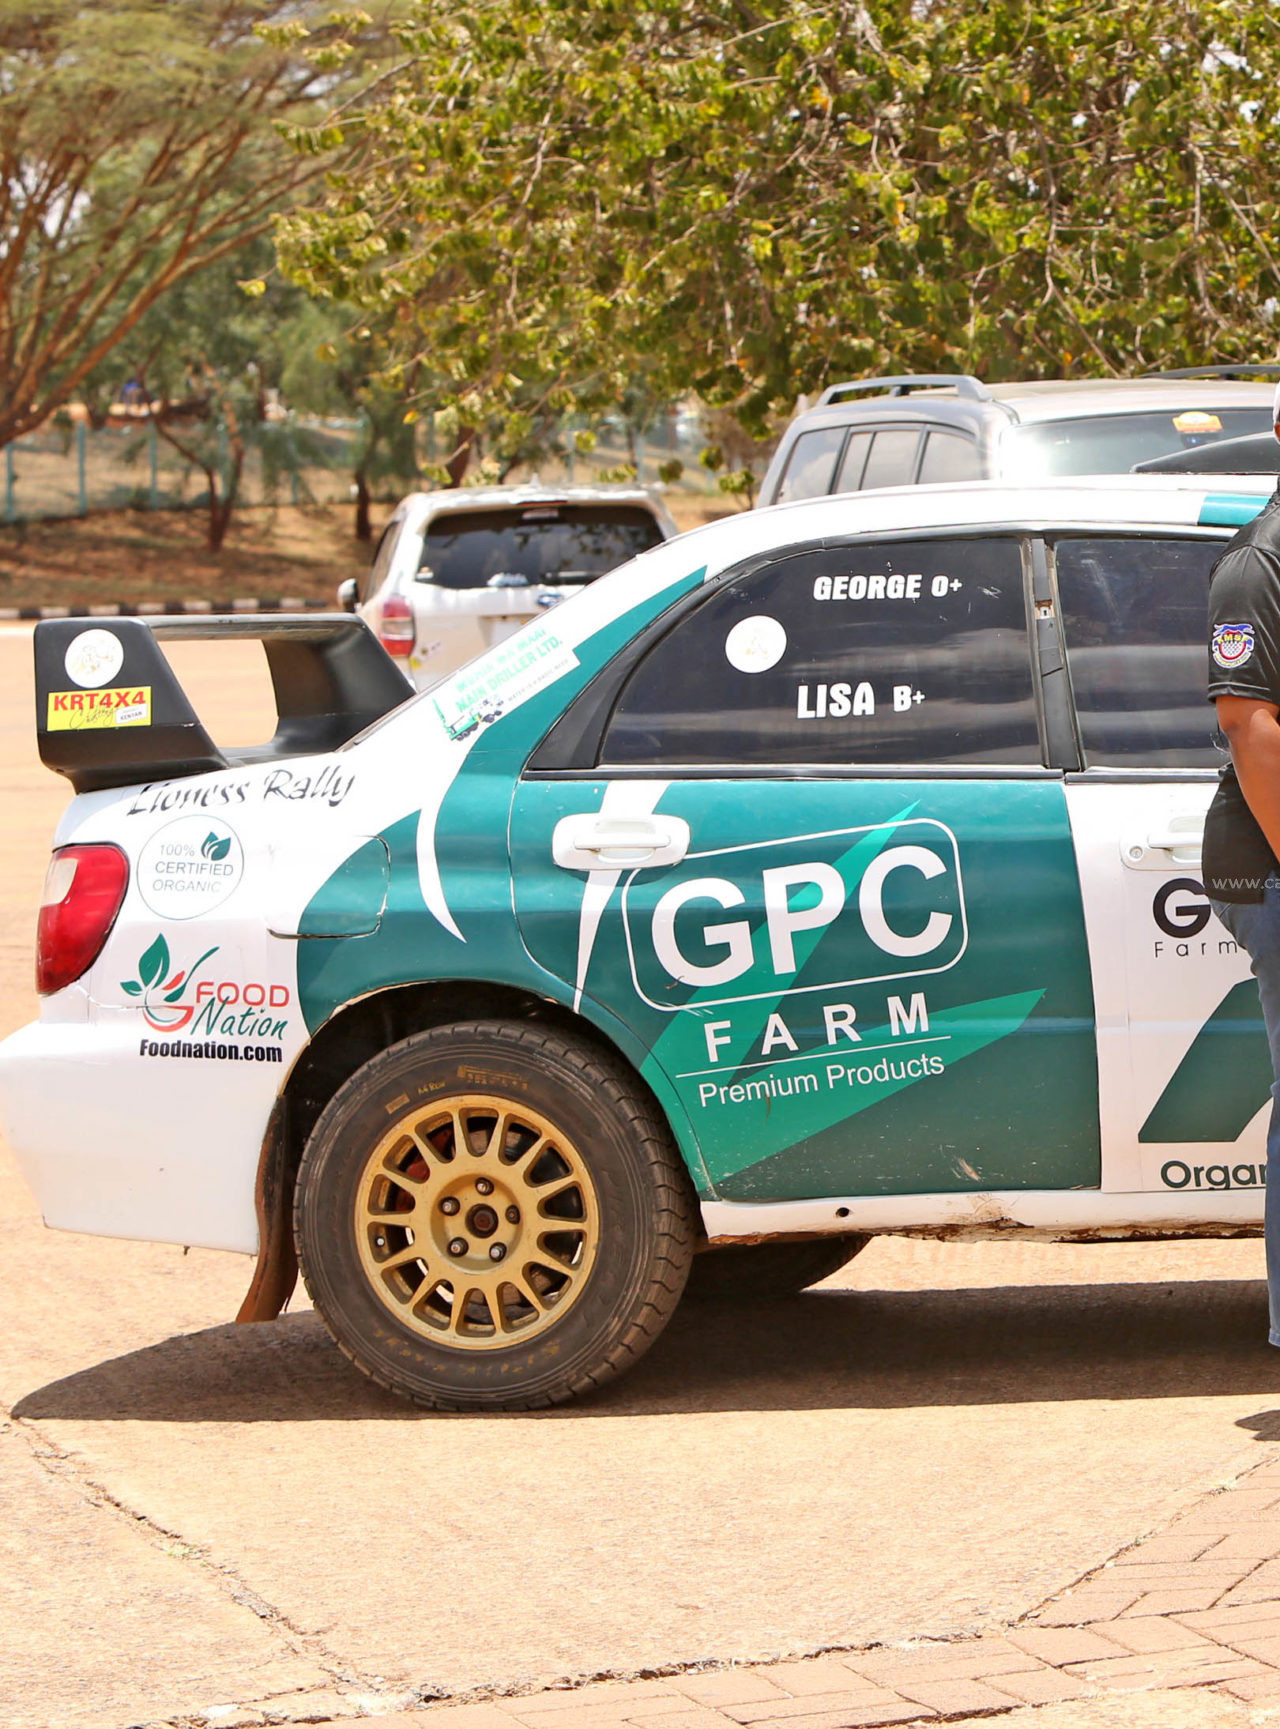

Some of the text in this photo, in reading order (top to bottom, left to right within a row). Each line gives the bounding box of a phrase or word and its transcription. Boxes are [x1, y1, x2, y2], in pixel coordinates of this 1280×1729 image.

[813, 574, 963, 601] GEORGE O+
[53, 691, 147, 711] KRT4X4
[797, 681, 926, 719] LISA B+
[127, 765, 356, 816] Lioness Rally
[160, 843, 195, 857] 100%
[155, 861, 234, 876] CERTIFIED
[152, 879, 222, 892] ORGANIC
[651, 845, 953, 987] GPC
[196, 981, 290, 1007] FOOD
[190, 995, 288, 1040] Nation
[703, 992, 930, 1063] FARM
[139, 1039, 283, 1063] Foodnation.com
[698, 1053, 945, 1107] Premium Products
